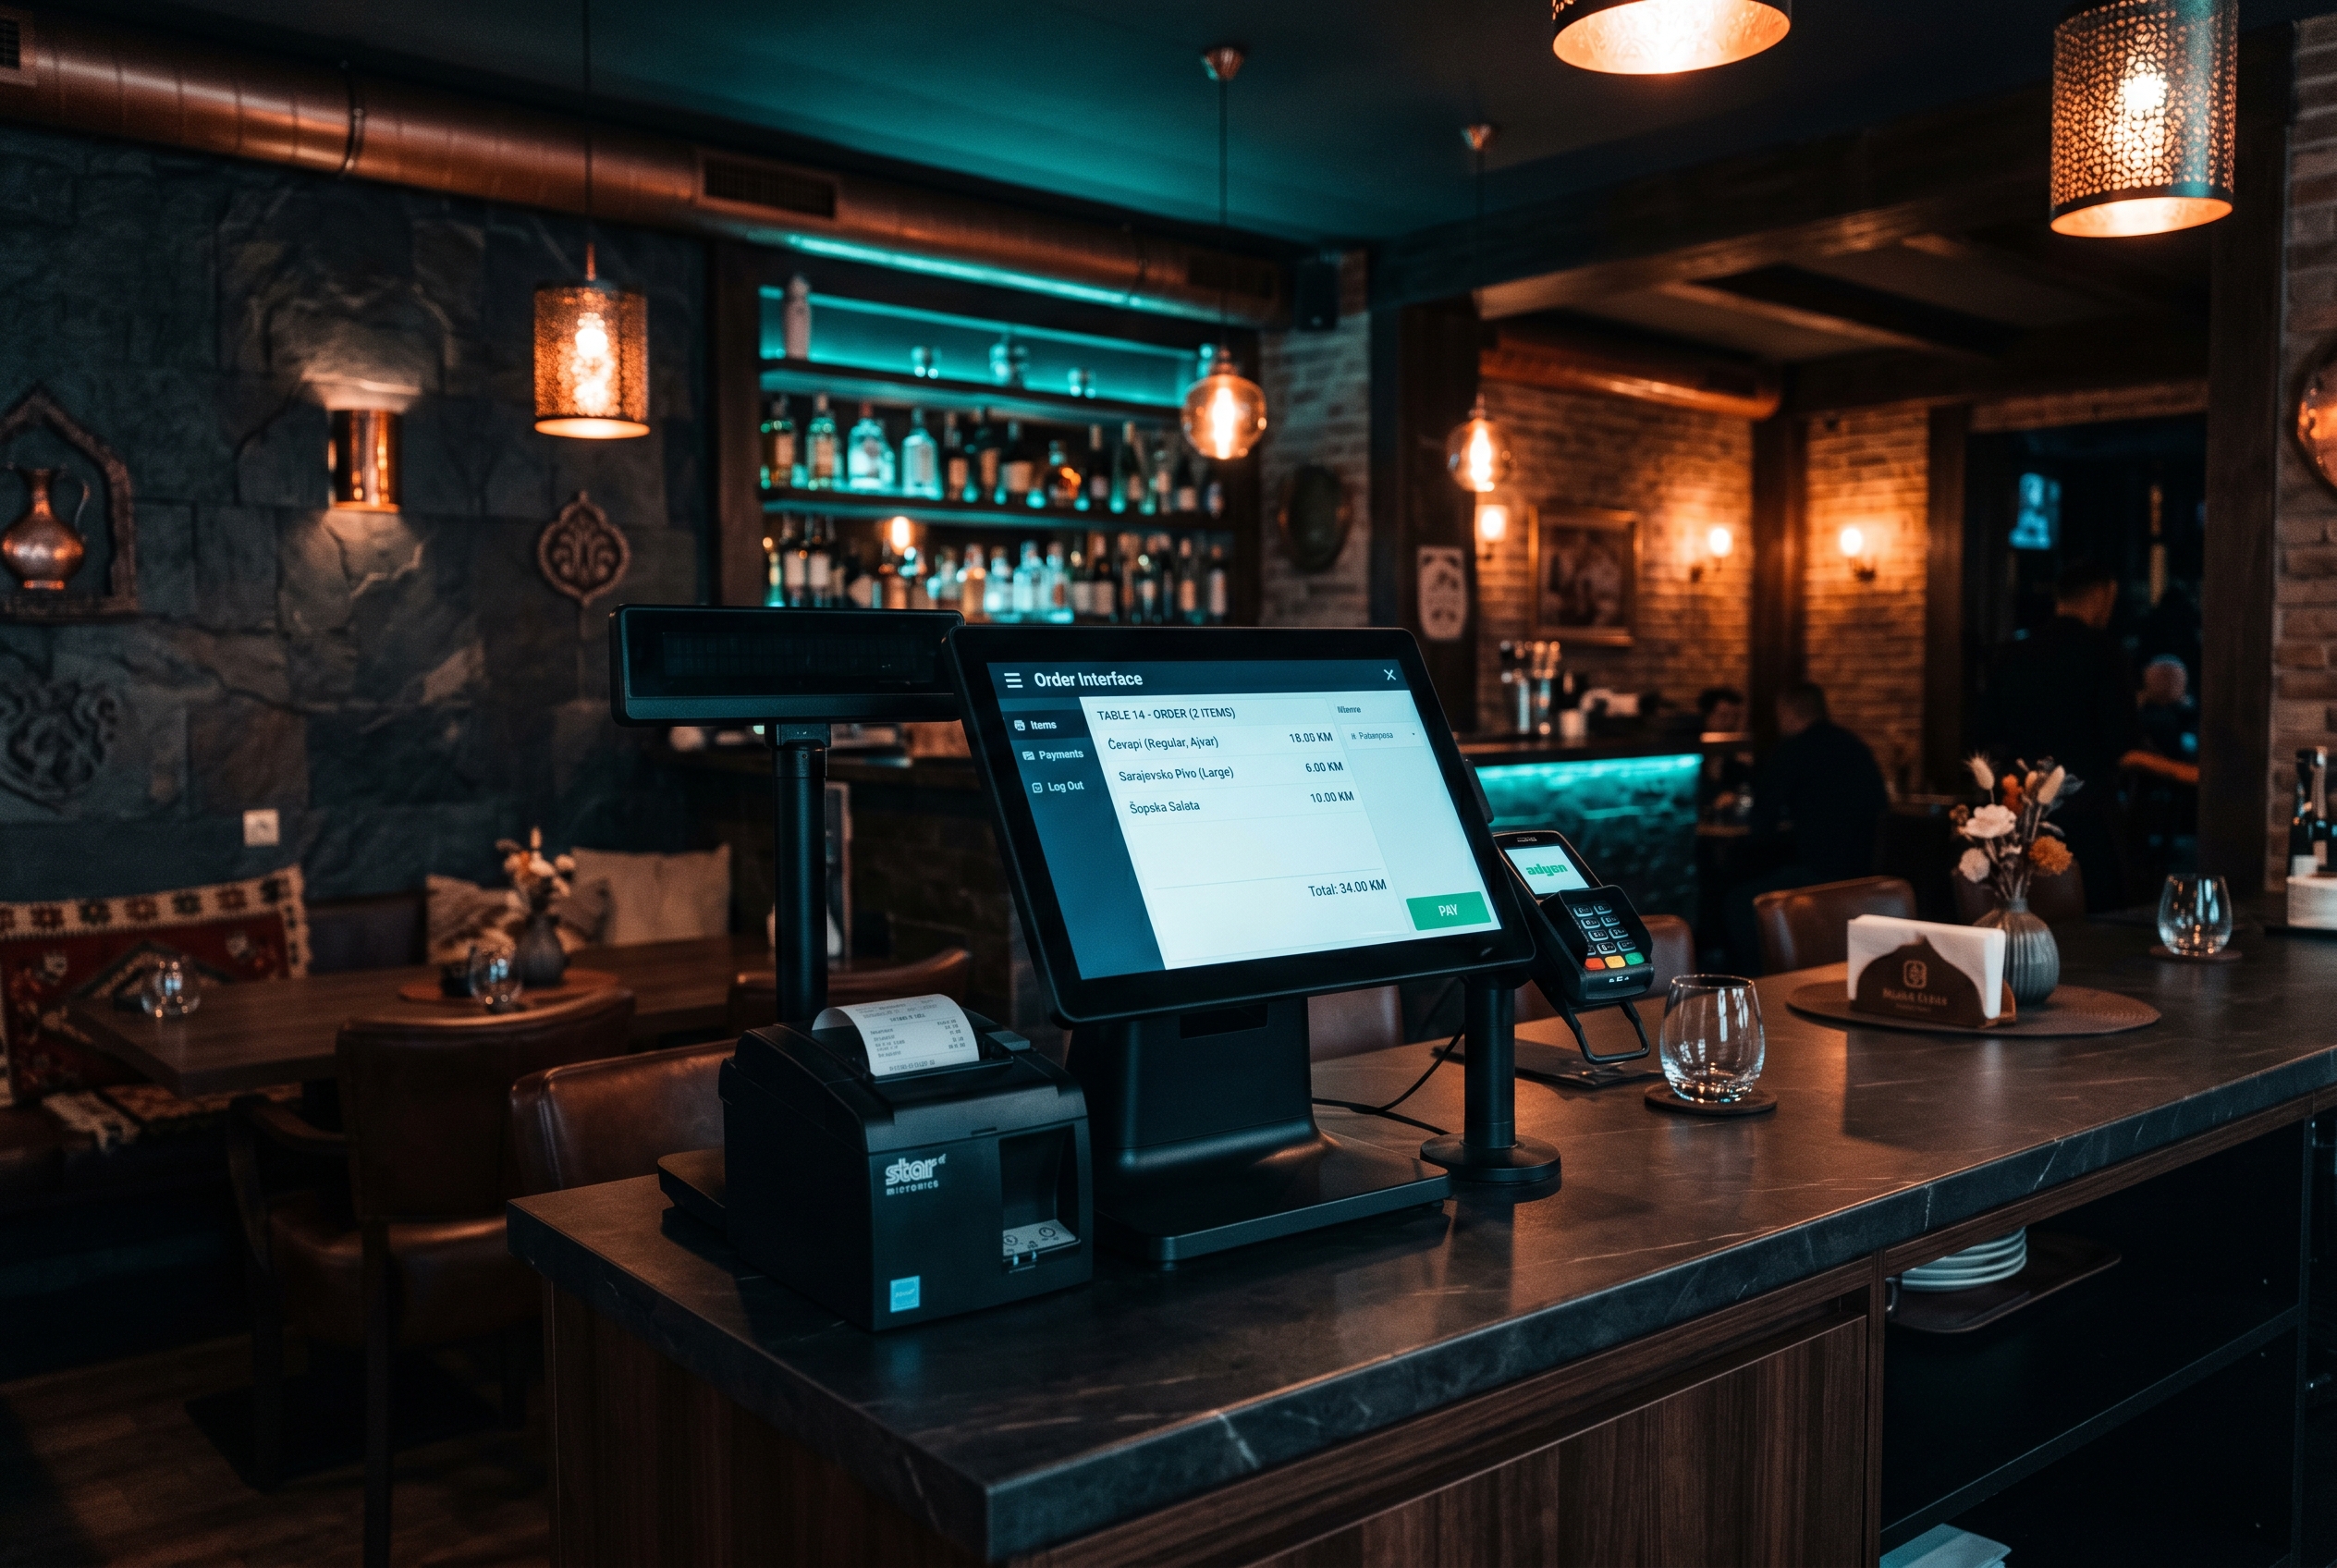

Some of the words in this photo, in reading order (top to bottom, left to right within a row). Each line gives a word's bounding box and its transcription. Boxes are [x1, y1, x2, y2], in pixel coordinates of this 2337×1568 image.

[1034, 671, 1075, 687] Order
[1078, 671, 1144, 686] Interface
[1097, 710, 1131, 721] TABLE
[1132, 710, 1145, 719] 14
[1153, 708, 1187, 719] ORDER
[1189, 708, 1200, 720] (2
[1201, 706, 1236, 719] ITEMS)
[1030, 720, 1057, 730] Items
[1316, 732, 1334, 741] KM
[1144, 737, 1189, 751] (Regular,
[1190, 736, 1219, 750] Ajvar)
[1305, 762, 1327, 773] 6.00
[1327, 761, 1344, 771] KM
[1119, 769, 1174, 783] Sarajevsko
[1175, 768, 1197, 779] Pivo
[1198, 766, 1234, 780] (Large)
[1047, 782, 1067, 792] Log
[1067, 781, 1084, 791] Out
[1310, 791, 1337, 803] 10.00
[1337, 790, 1355, 802] KM
[1168, 800, 1201, 812] Salata
[1307, 883, 1339, 897] Total:
[1339, 880, 1368, 894] 34.00
[1369, 878, 1388, 891] KM
[1438, 904, 1459, 917] PAY
[885, 1157, 937, 1186] star
